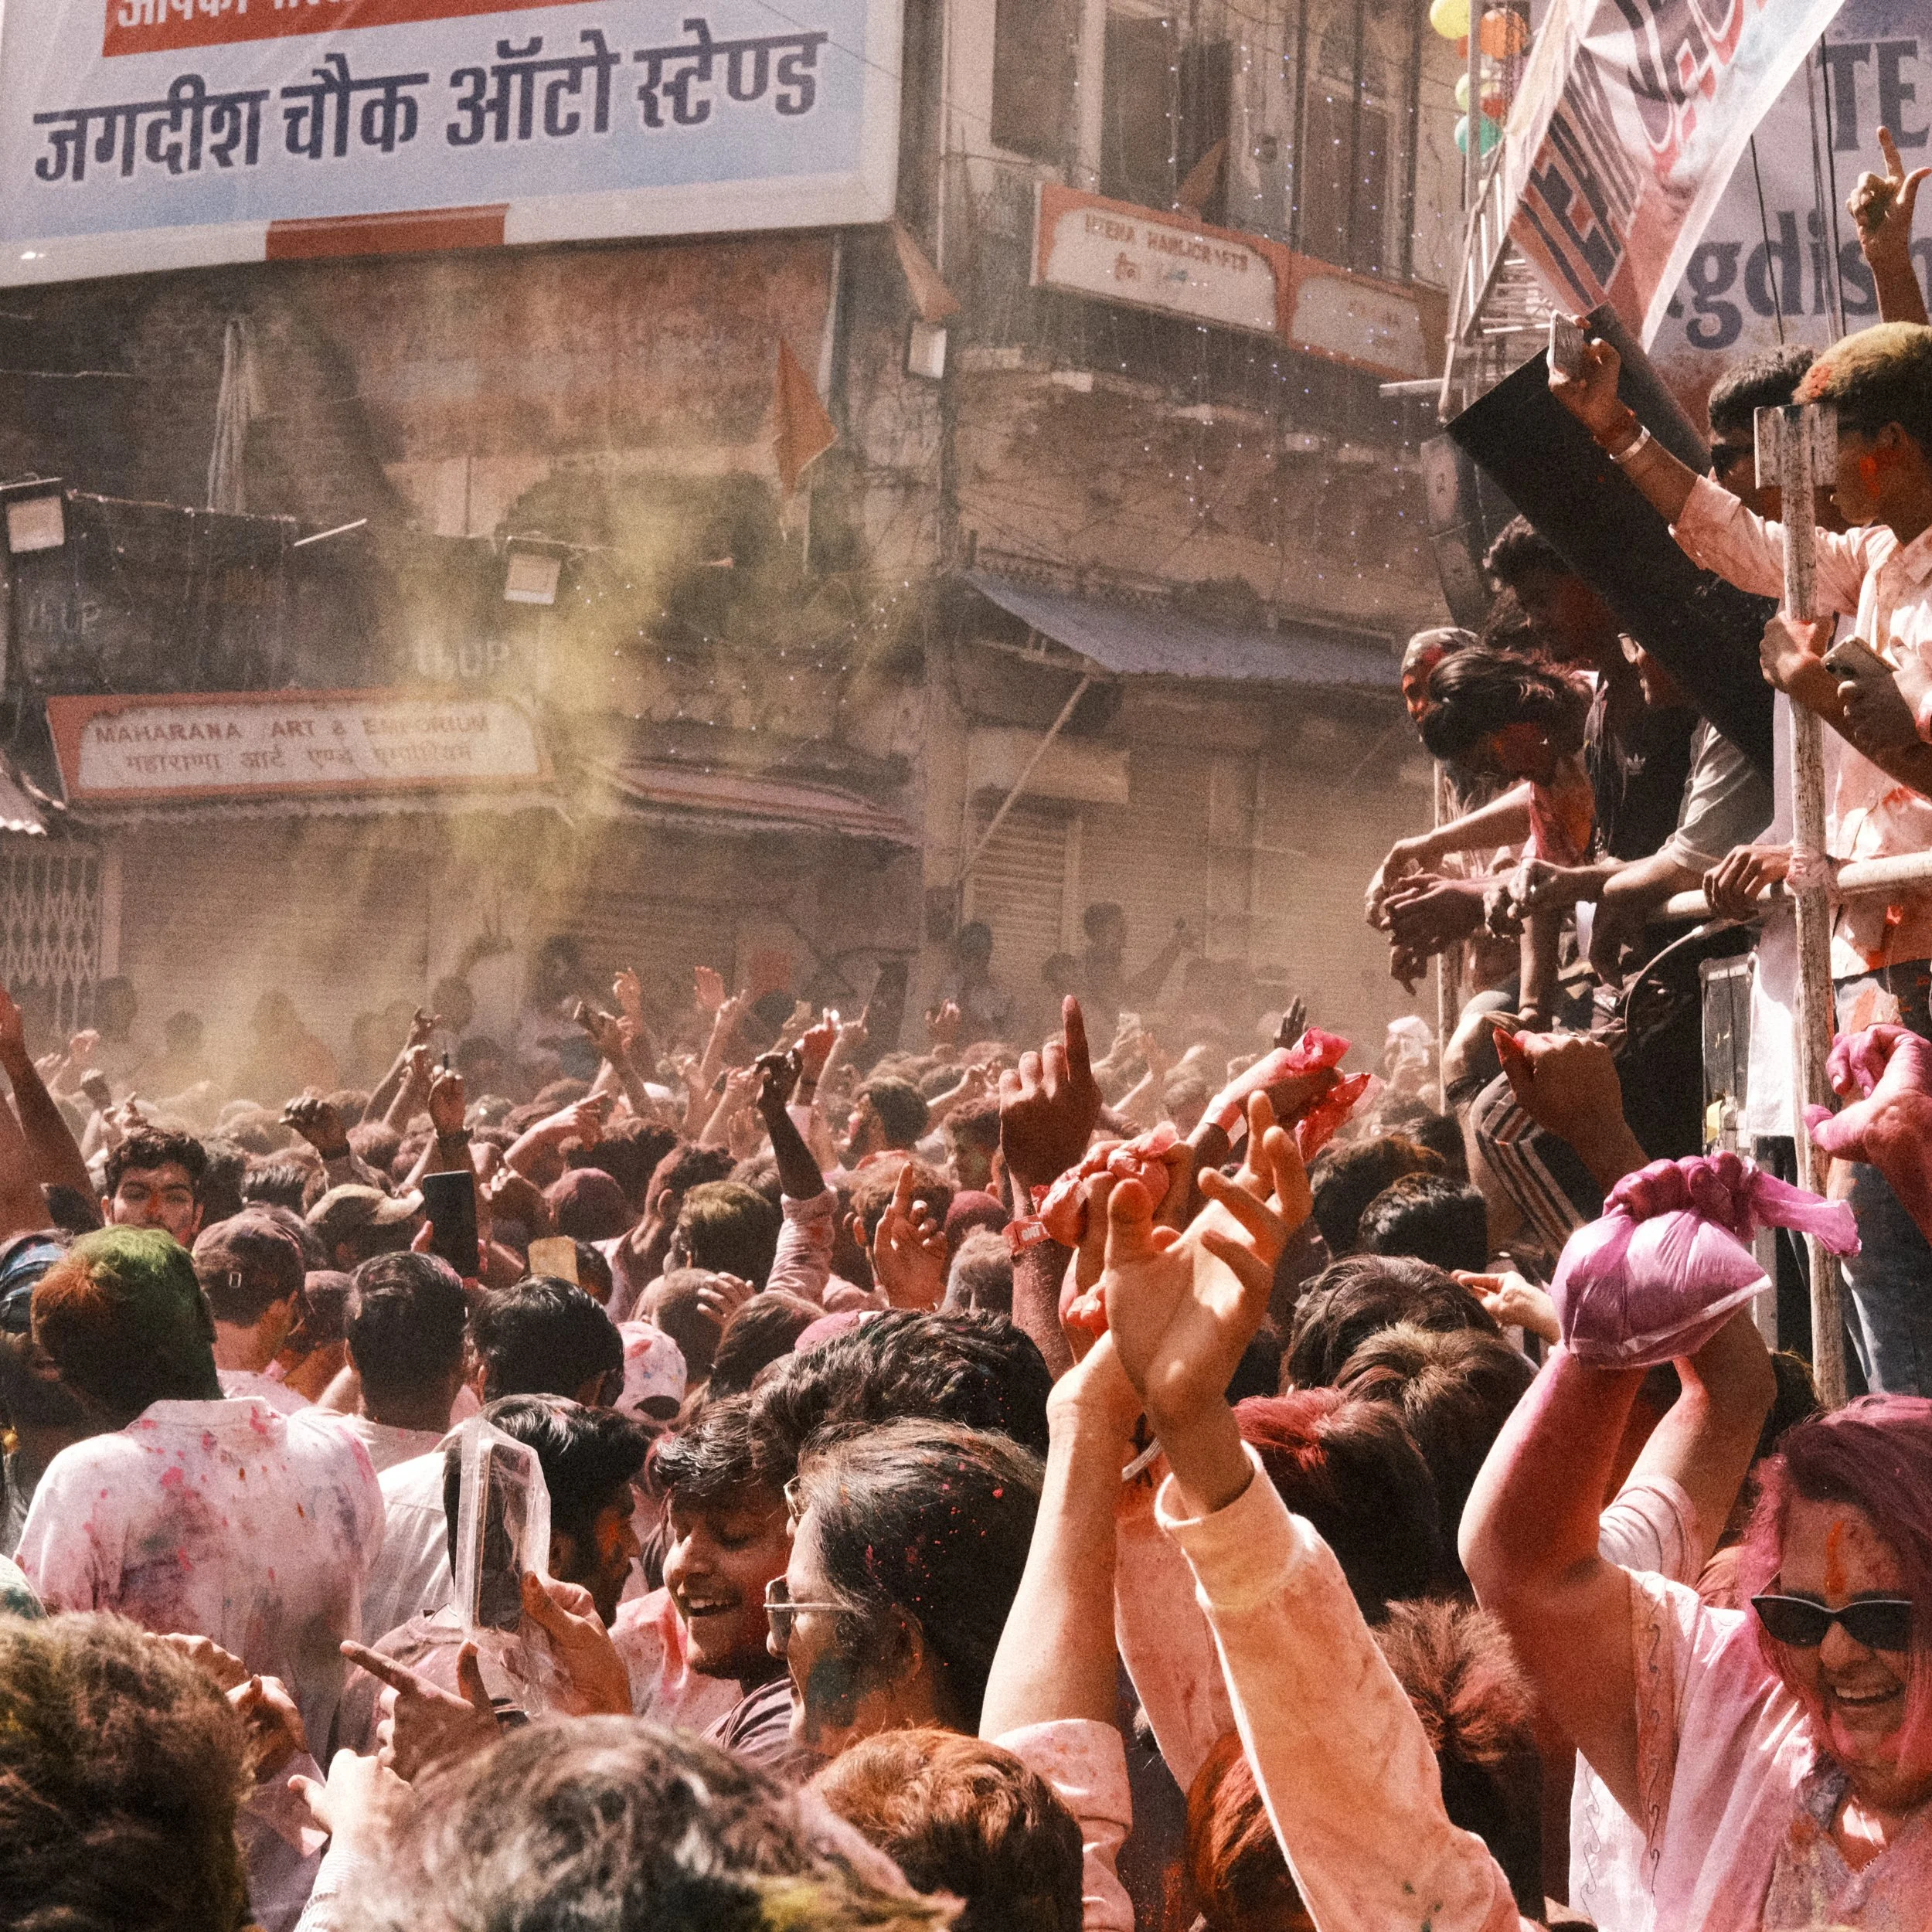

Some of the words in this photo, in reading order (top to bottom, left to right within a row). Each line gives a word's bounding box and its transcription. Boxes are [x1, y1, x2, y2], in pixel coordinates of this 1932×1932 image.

[33, 73, 270, 182] जगदीश
[281, 53, 430, 159] चौक
[446, 29, 621, 146] ऑटो
[633, 18, 829, 128] स्टेण्ड
[1666, 210, 1932, 351] gdis
[95, 722, 242, 743] MAHARANA
[270, 719, 315, 738] ART
[363, 713, 488, 736] EMPORIUM
